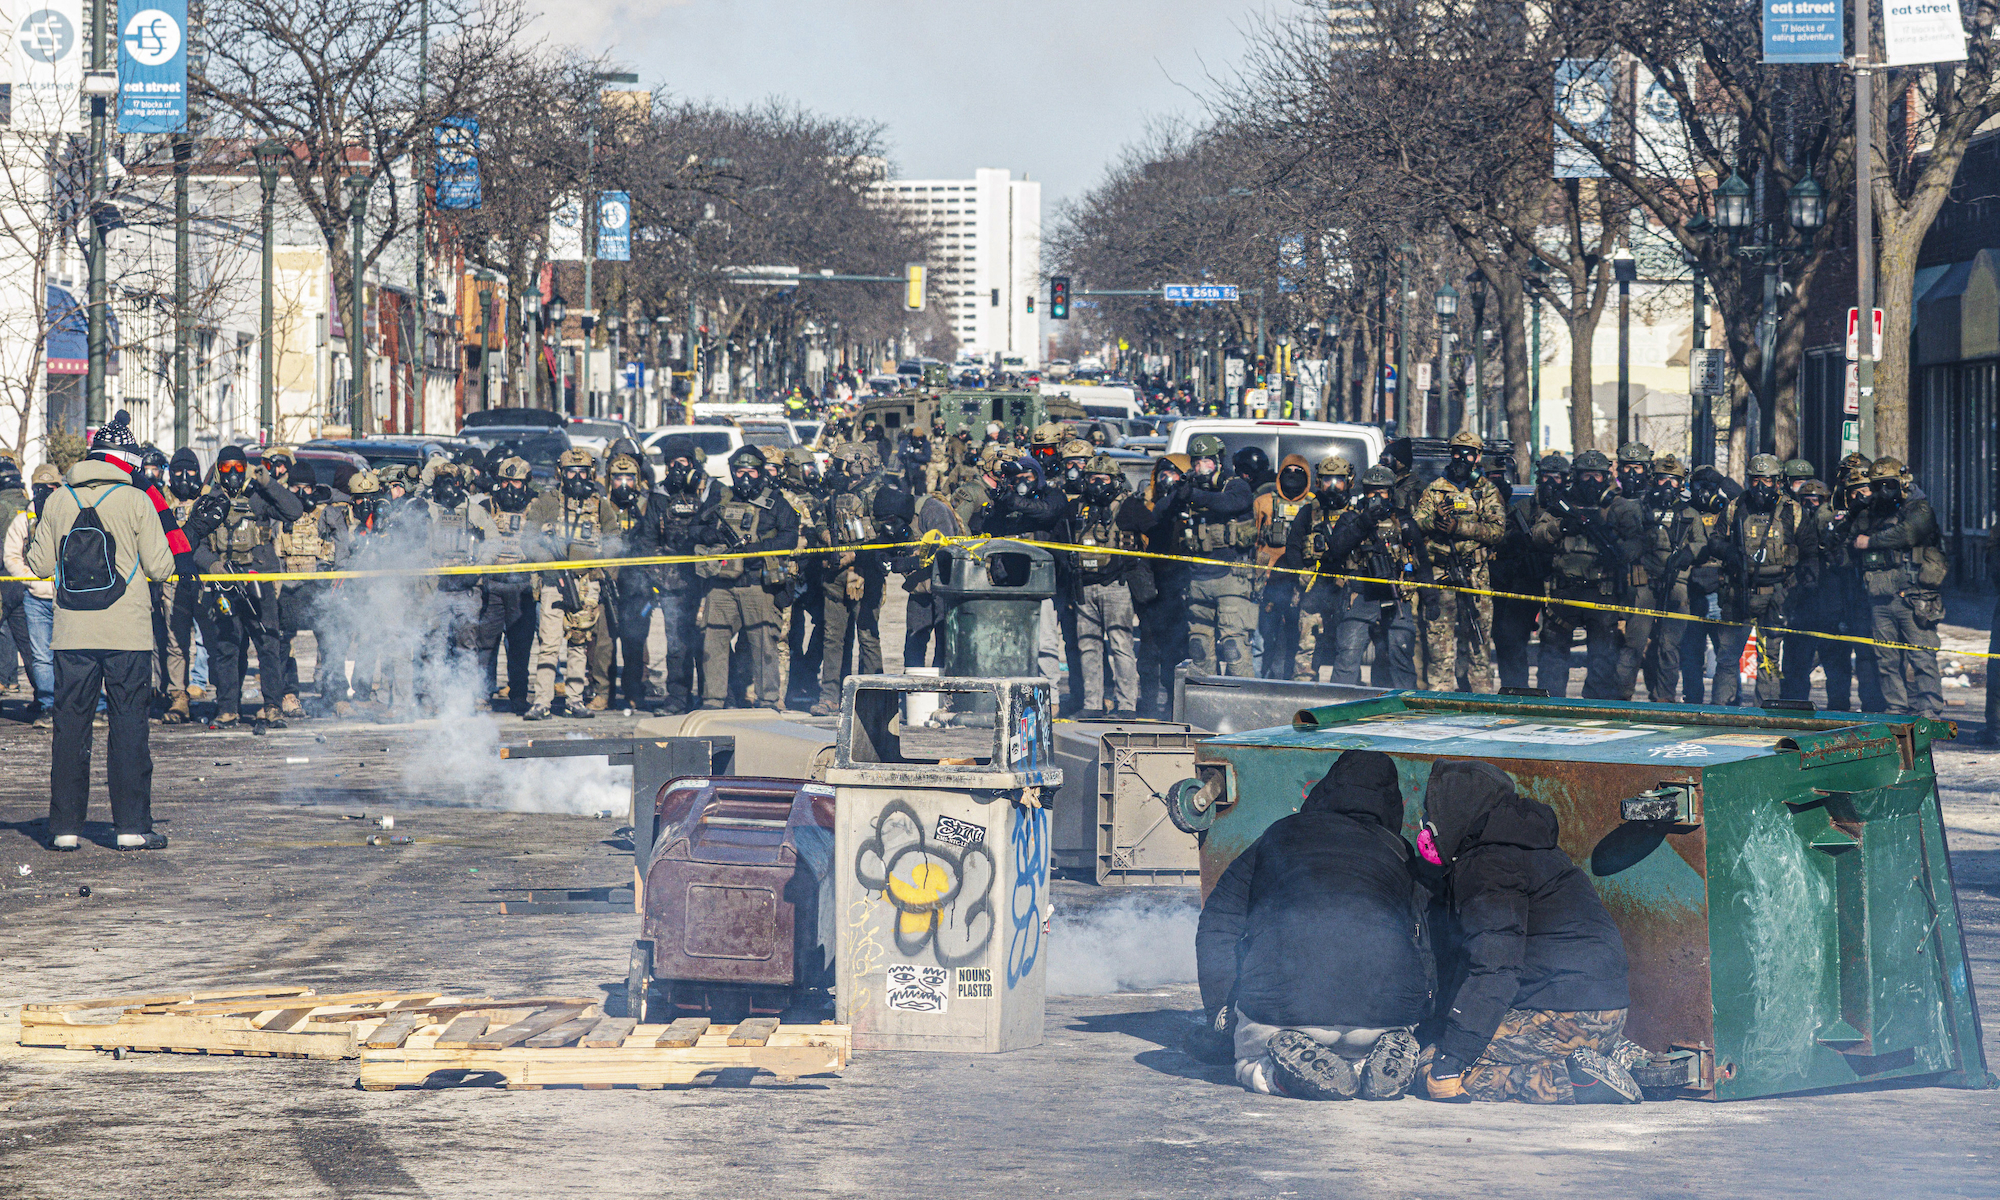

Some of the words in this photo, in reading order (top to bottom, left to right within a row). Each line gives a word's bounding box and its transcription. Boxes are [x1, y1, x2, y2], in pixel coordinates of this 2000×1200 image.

[1770, 1, 1794, 15] eat
[1795, 1, 1836, 14] street
[1891, 4, 1913, 16] eat
[1915, 3, 1952, 15] street
[1780, 24, 1789, 33] 17
[1790, 23, 1815, 33] blocks
[1816, 23, 1826, 33] of
[1771, 33, 1796, 43] eating
[1796, 33, 1835, 42] adventure
[123, 81, 144, 93] eat
[145, 81, 181, 93] street
[132, 100, 140, 108] 17
[141, 100, 163, 109] blocks
[1192, 288, 1220, 298] 26th
[958, 969, 991, 982] NOUNS
[958, 983, 993, 998] PLASTER
